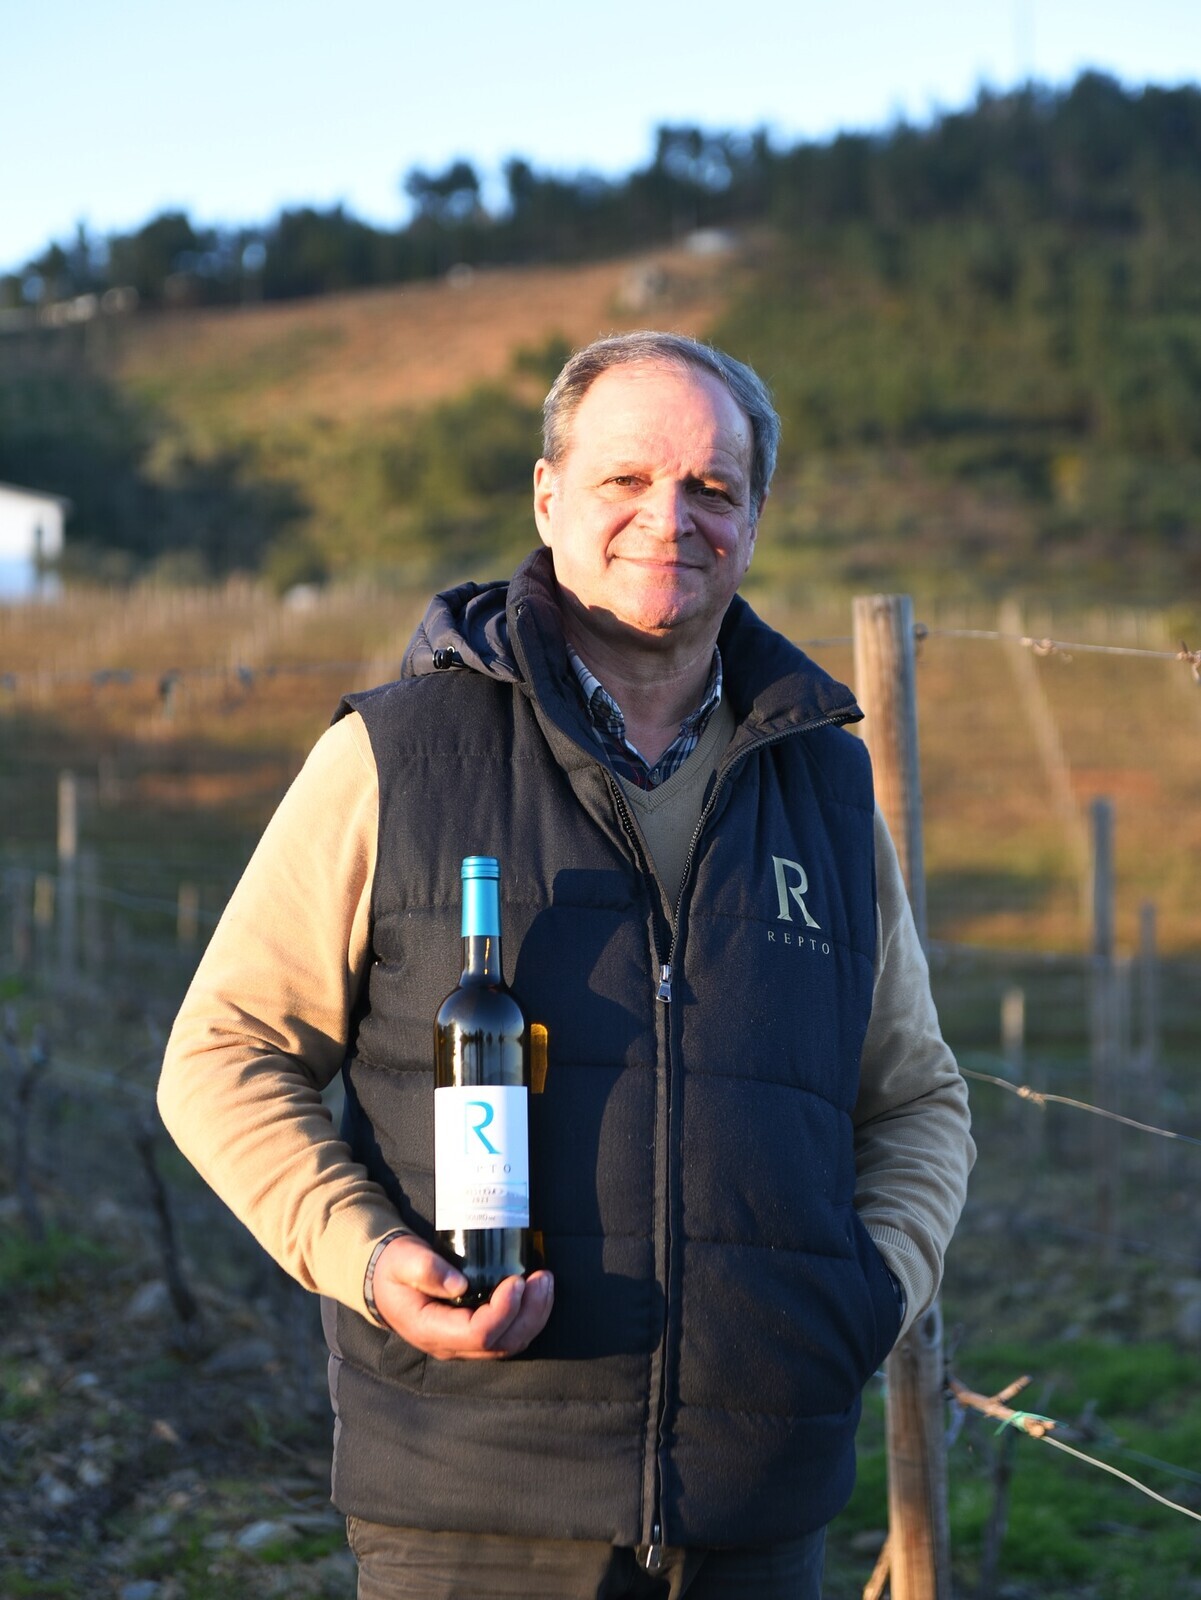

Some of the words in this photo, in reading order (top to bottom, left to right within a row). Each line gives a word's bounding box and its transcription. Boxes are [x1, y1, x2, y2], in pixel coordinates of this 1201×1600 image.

[771, 854, 822, 930] R
[767, 930, 830, 955] REPTO
[464, 1101, 503, 1155] R
